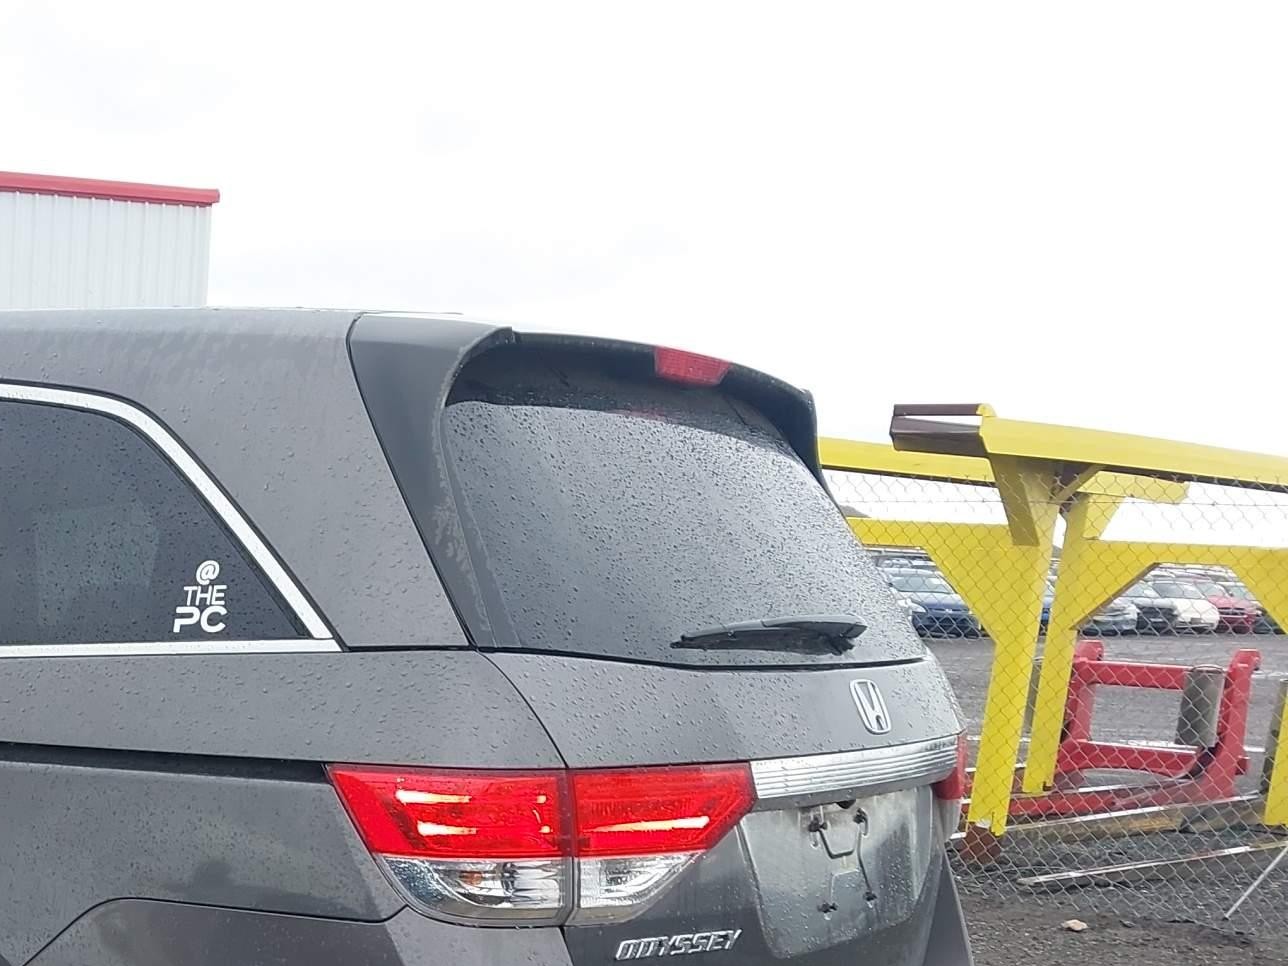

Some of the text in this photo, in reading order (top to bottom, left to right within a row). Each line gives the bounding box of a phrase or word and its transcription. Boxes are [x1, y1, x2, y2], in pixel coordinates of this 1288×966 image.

[183, 584, 228, 606] THE
[172, 605, 228, 633] PC
[615, 928, 743, 961] ODYSSEY
